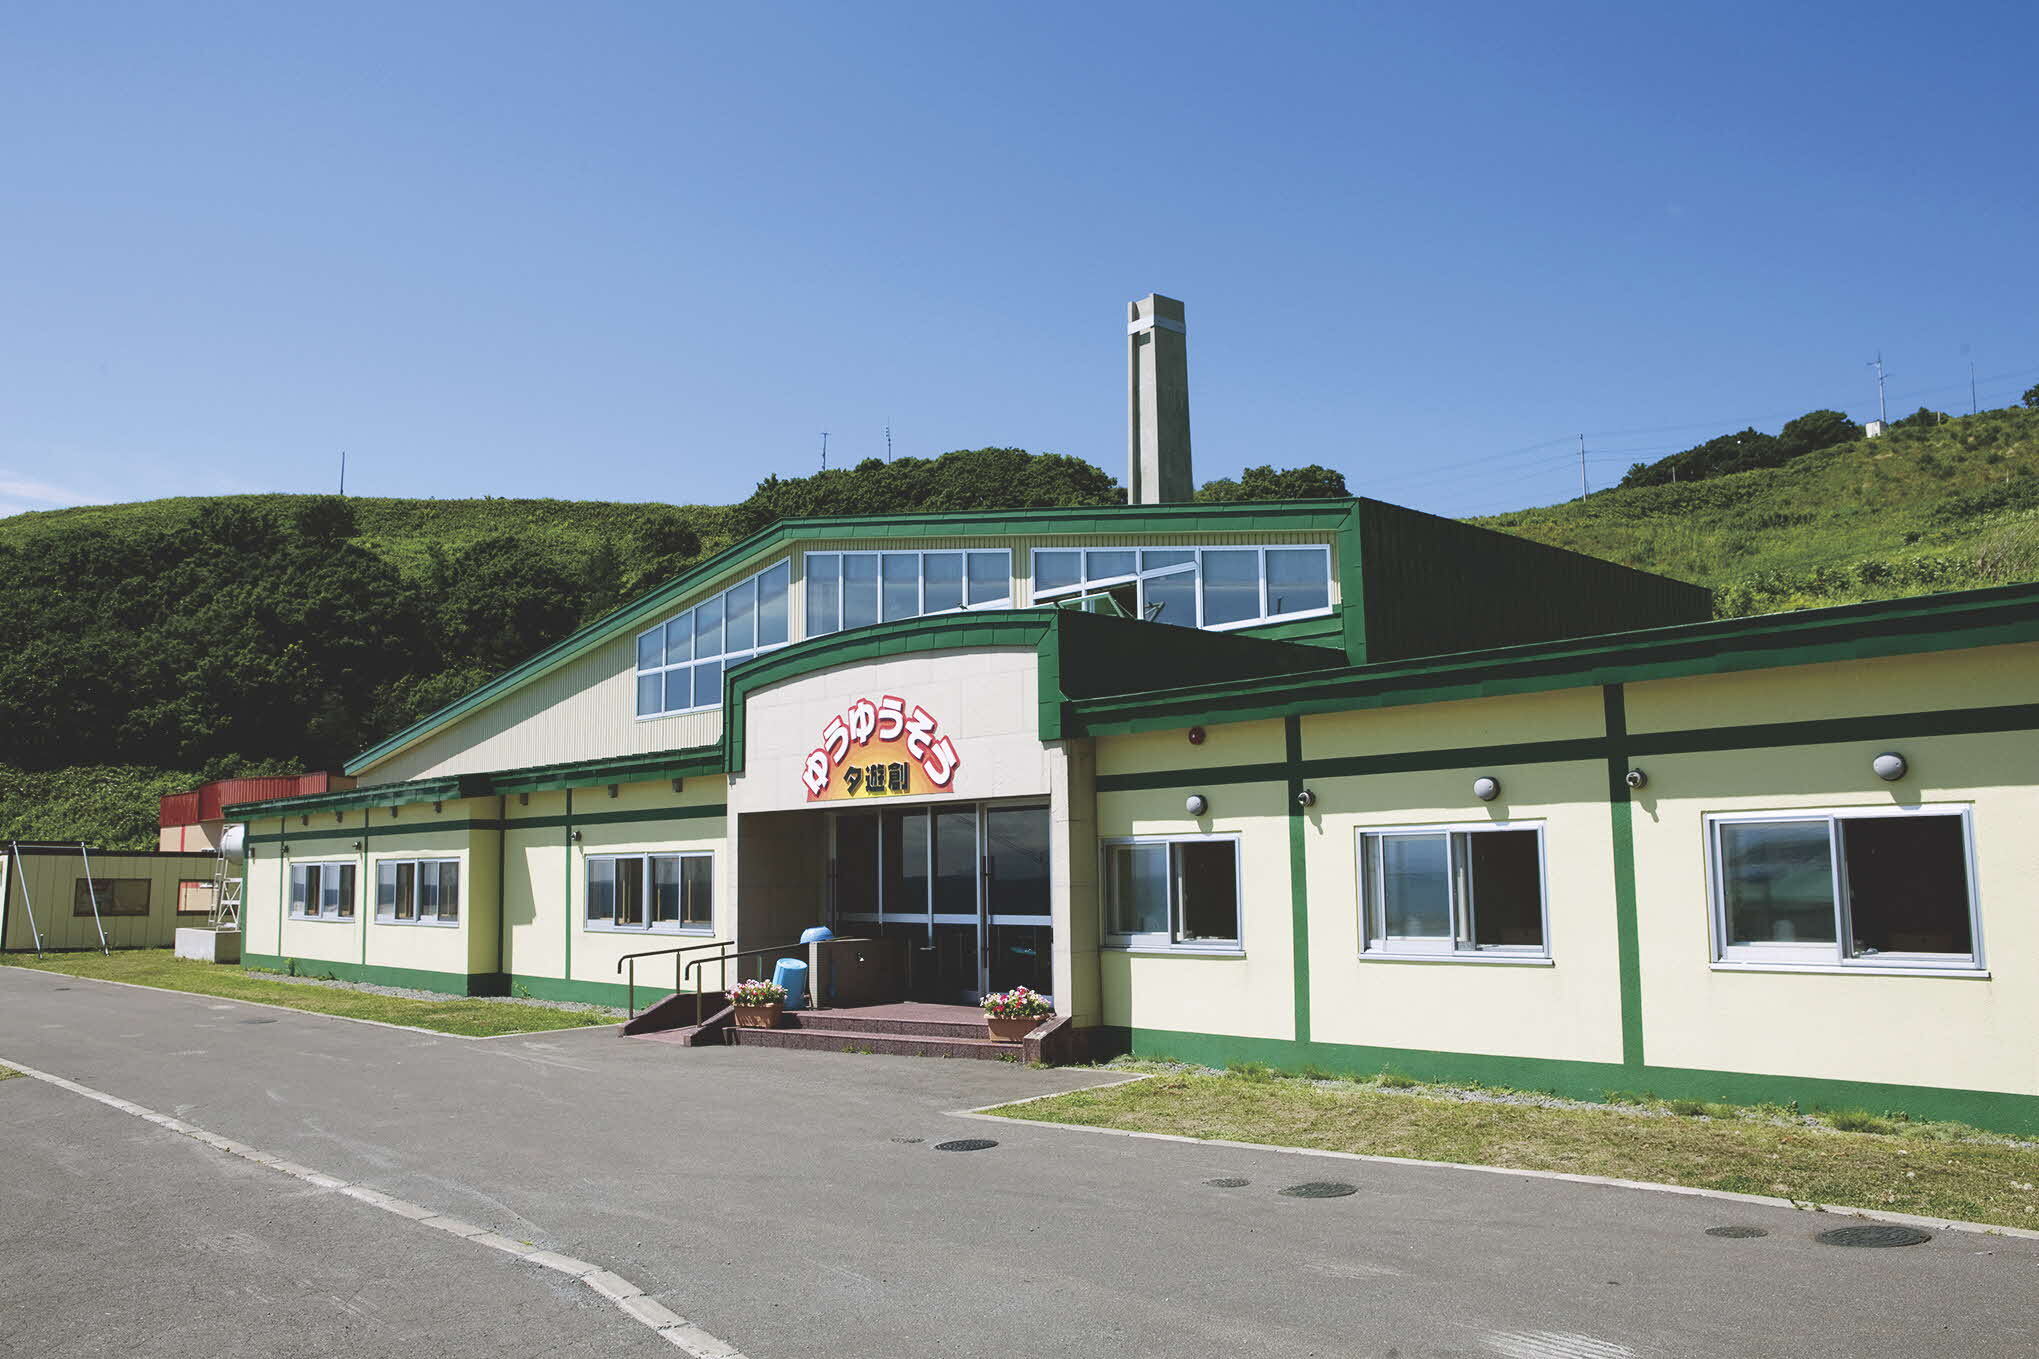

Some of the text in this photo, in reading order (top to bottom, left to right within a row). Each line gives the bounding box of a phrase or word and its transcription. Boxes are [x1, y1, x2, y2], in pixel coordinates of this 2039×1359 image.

[802, 696, 959, 796] ゆうゆうそう
[844, 762, 909, 796] 夕遊創
